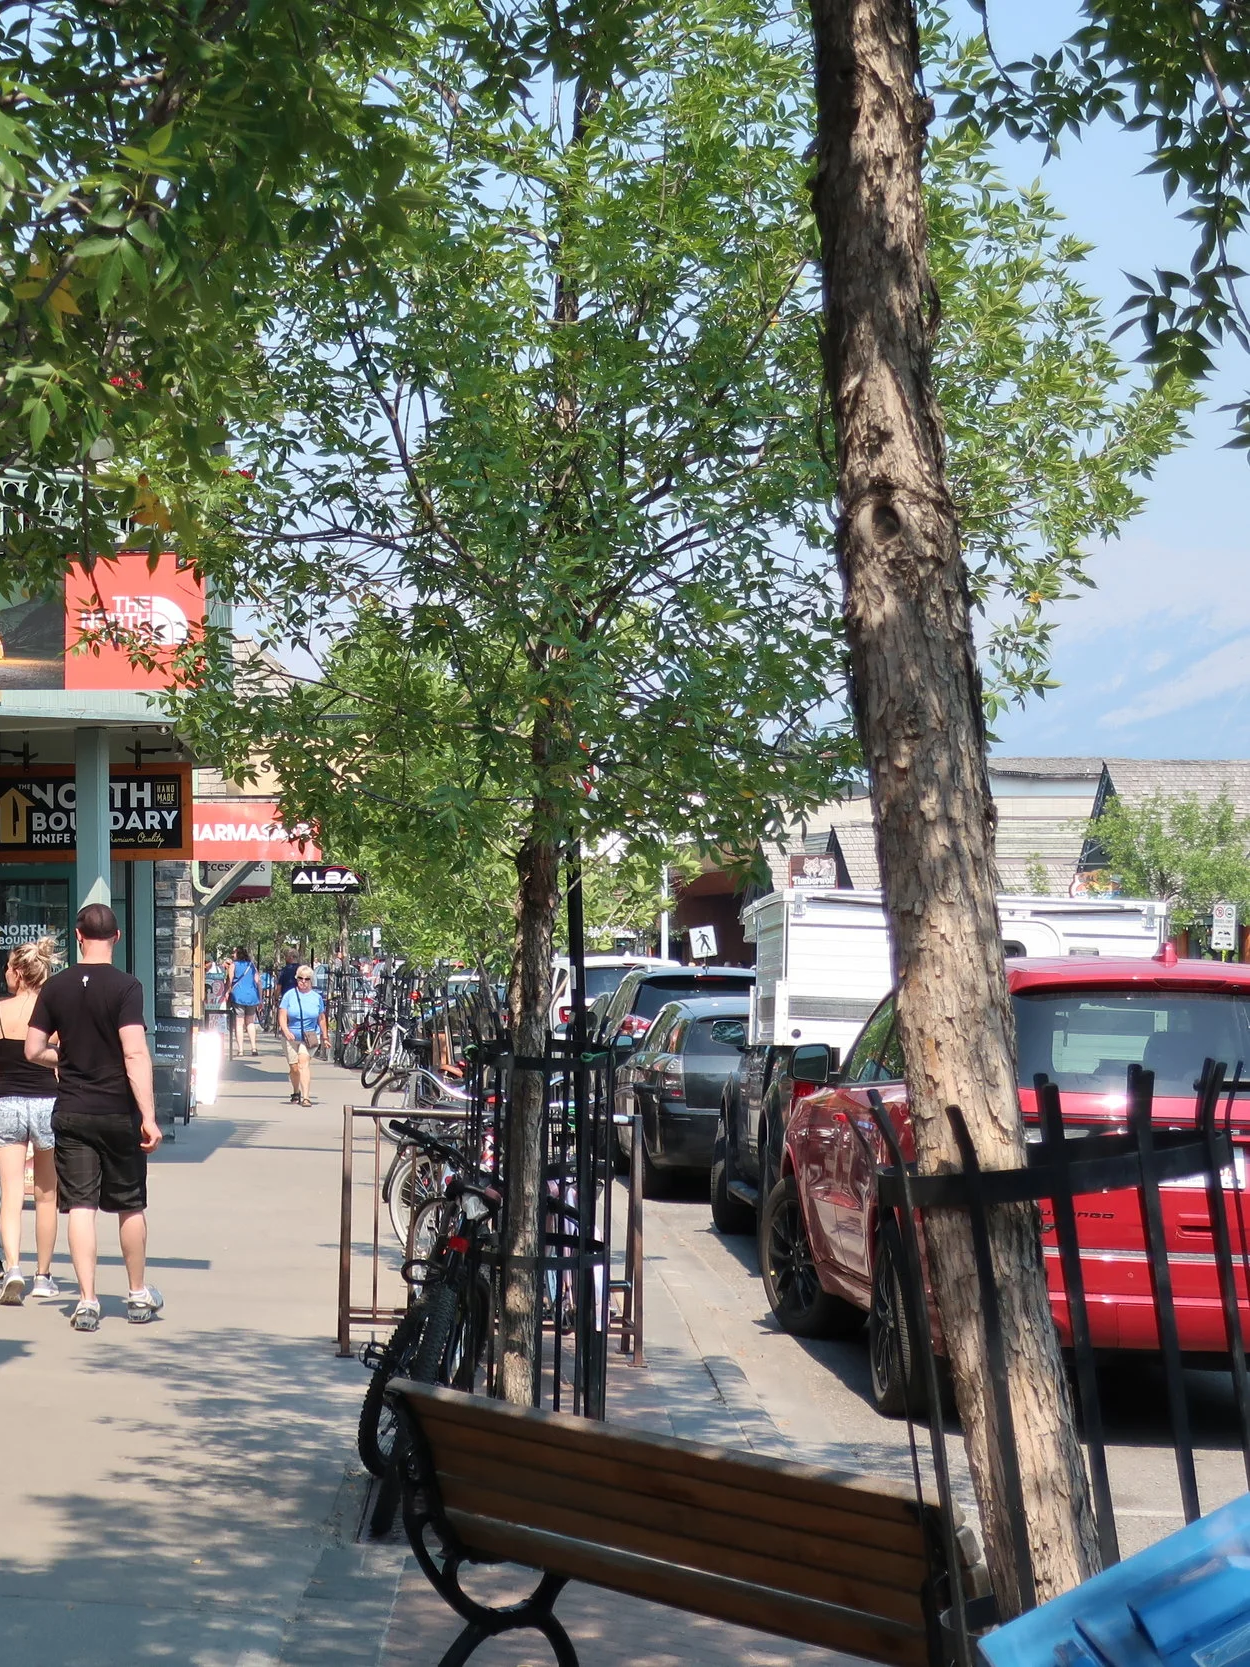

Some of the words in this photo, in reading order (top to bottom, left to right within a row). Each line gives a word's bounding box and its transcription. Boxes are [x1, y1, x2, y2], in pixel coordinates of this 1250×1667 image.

[112, 596, 151, 612] THE
[157, 785, 175, 793] HAND
[31, 782, 151, 809] NOTH
[157, 793, 175, 802] MADE
[32, 834, 71, 844] KNIFE
[137, 832, 165, 848] Quality
[293, 871, 359, 885] ALBA
[792, 875, 836, 885] Timberwolf
[310, 884, 347, 892] Restaurant
